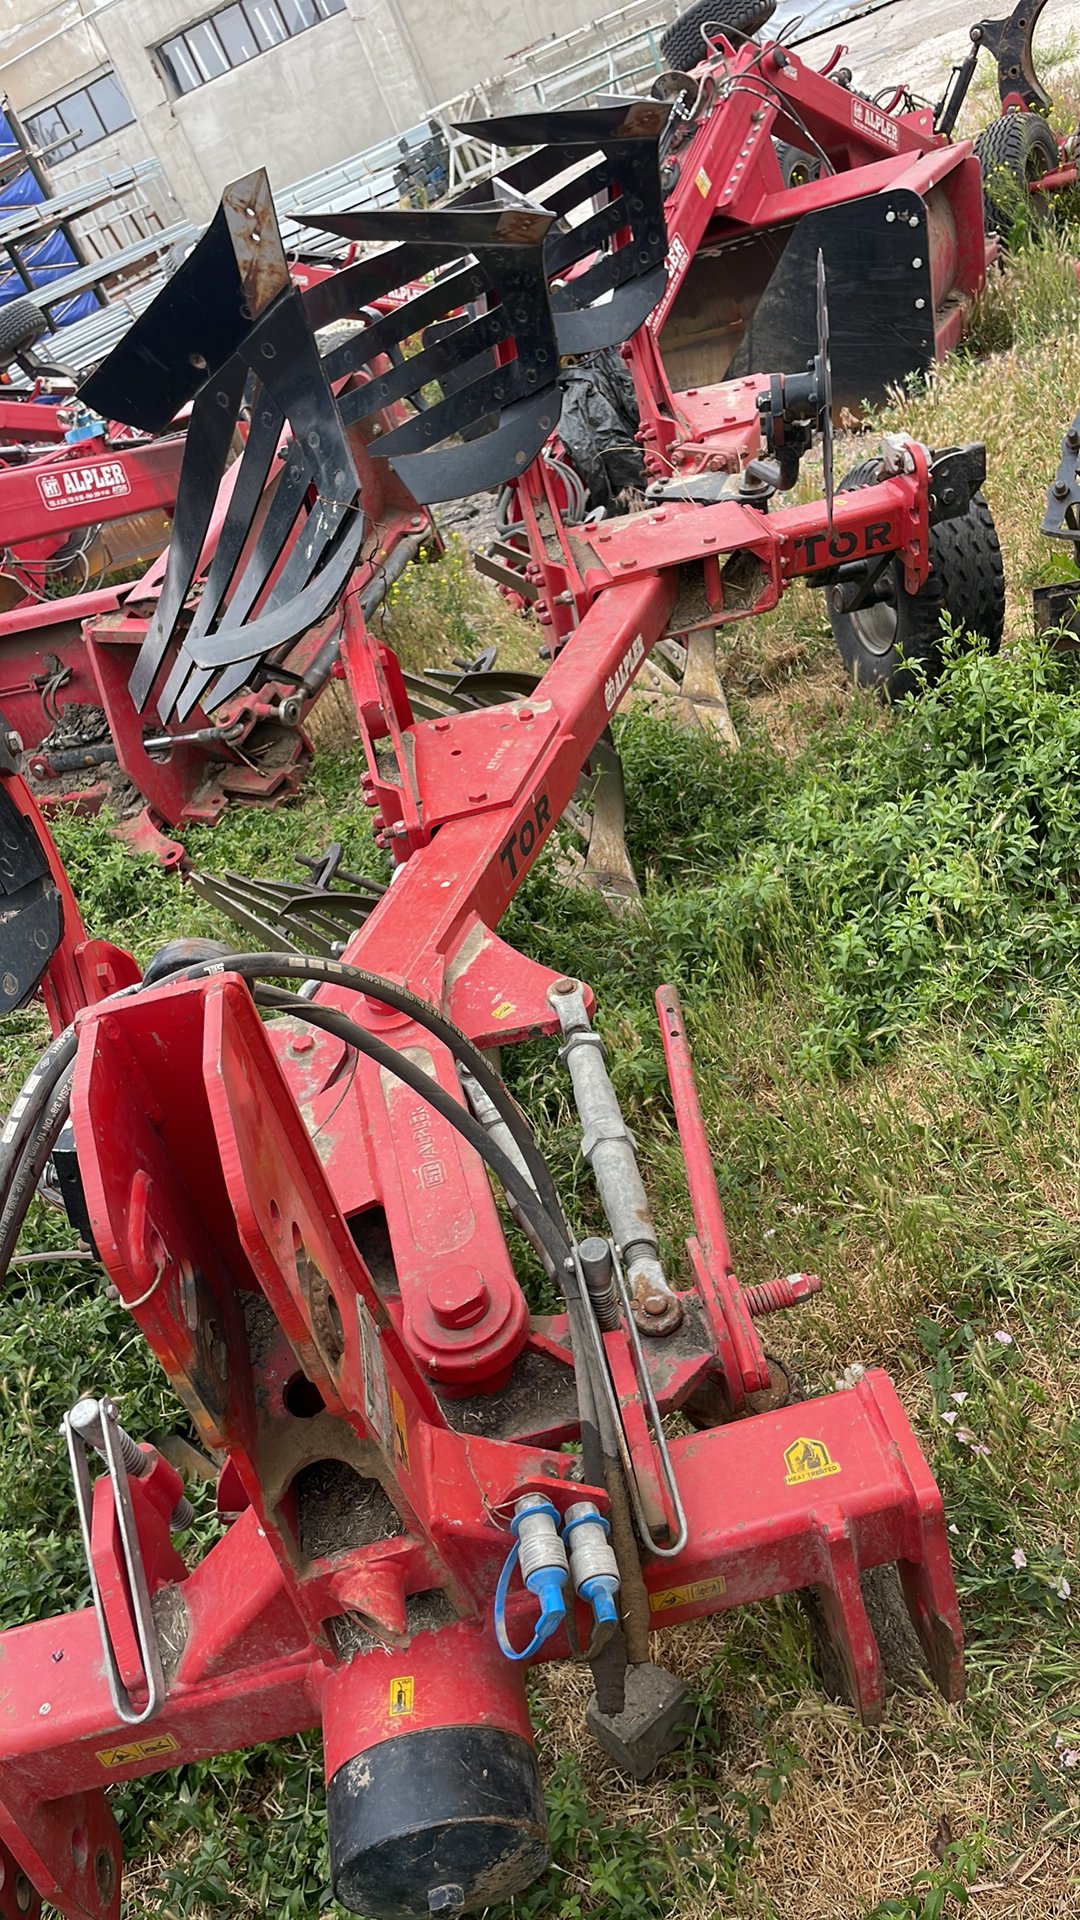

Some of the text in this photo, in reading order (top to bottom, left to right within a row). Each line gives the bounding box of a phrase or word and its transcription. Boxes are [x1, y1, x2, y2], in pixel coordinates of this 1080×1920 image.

[62, 464, 126, 494] ALPLER
[795, 521, 892, 566] TOR
[500, 794, 552, 880] TOR
[56, 1083, 72, 1102] 2SN
[41, 1117, 54, 1131] DN
[36, 1130, 47, 1142] 10
[28, 1141, 40, 1157] mm
[788, 1473, 806, 1482] HEAT
